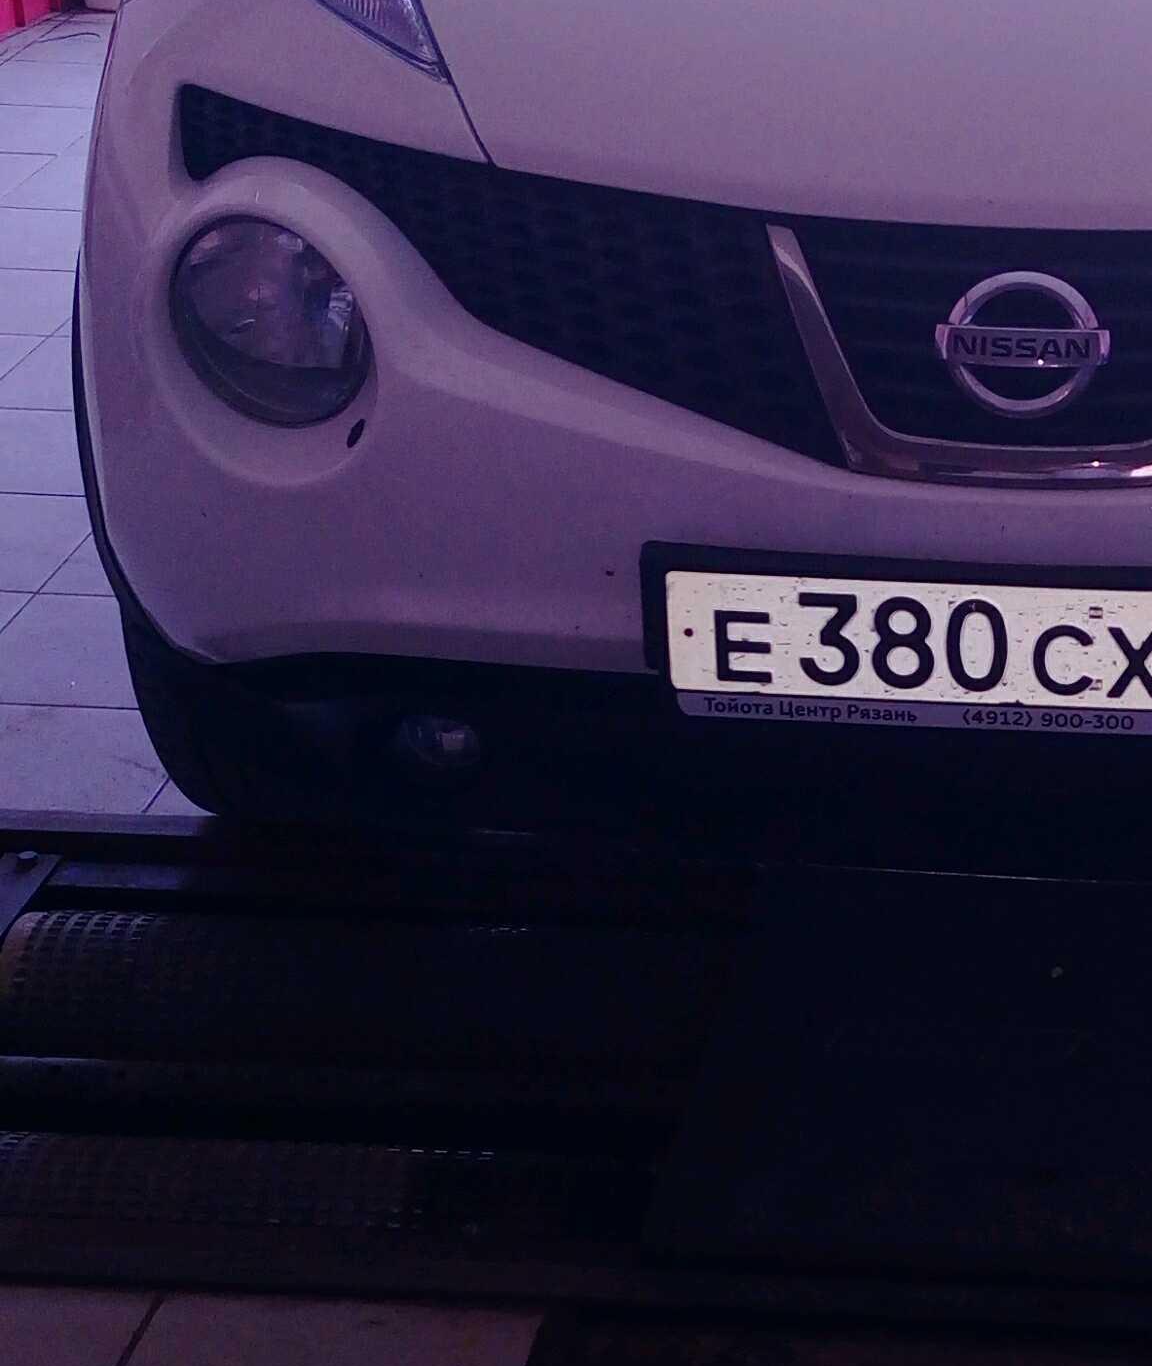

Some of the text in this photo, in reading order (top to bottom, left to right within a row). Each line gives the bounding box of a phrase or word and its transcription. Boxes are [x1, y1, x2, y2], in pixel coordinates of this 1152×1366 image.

[953, 334, 1091, 360] NISSAN
[703, 696, 773, 717] Тойота
[778, 702, 842, 723] Центр
[847, 705, 917, 724] Рязань
[1040, 711, 1135, 731] 900-300
